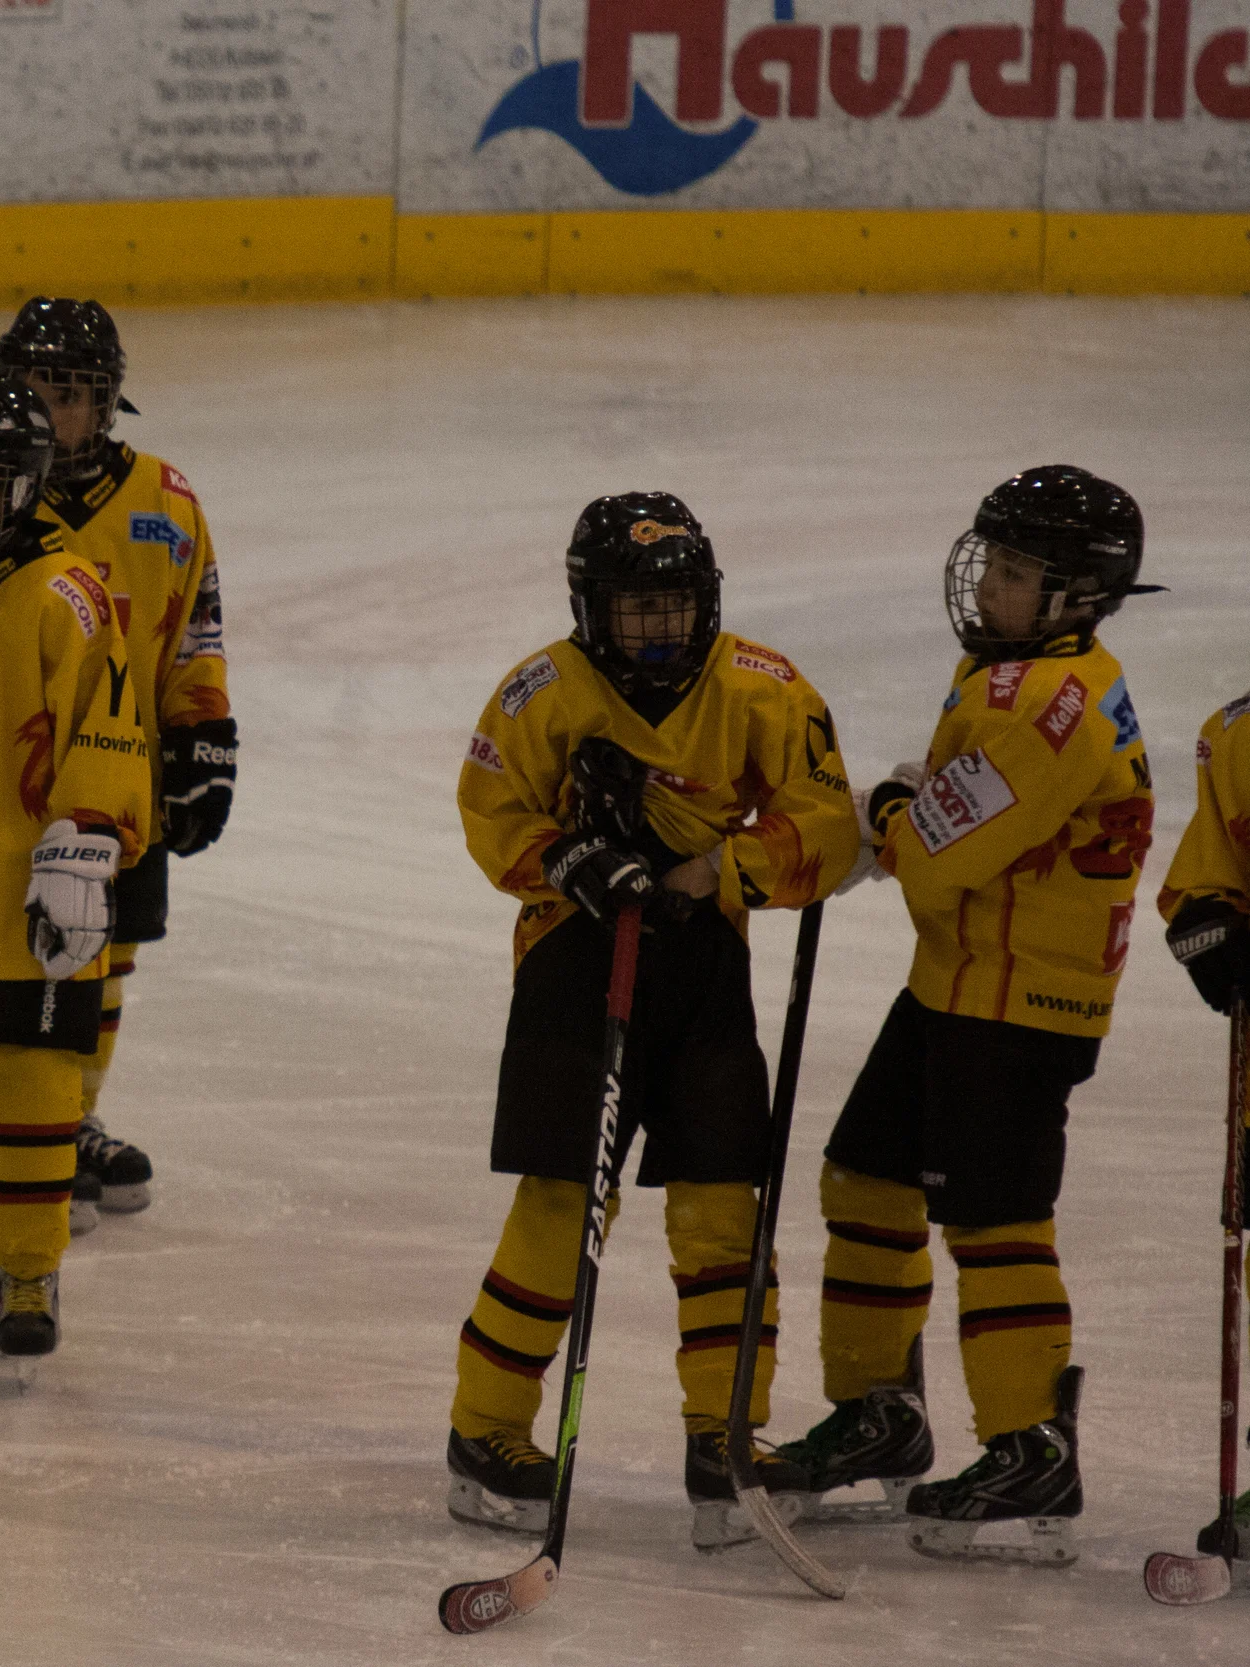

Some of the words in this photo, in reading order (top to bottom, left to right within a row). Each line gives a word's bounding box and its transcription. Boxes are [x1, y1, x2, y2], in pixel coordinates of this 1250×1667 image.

[52, 578, 94, 637] RICOH
[736, 656, 790, 679] RICO
[1046, 683, 1084, 738] Kelly's
[94, 731, 137, 754] lovin'
[586, 1072, 622, 1270] EASTON
